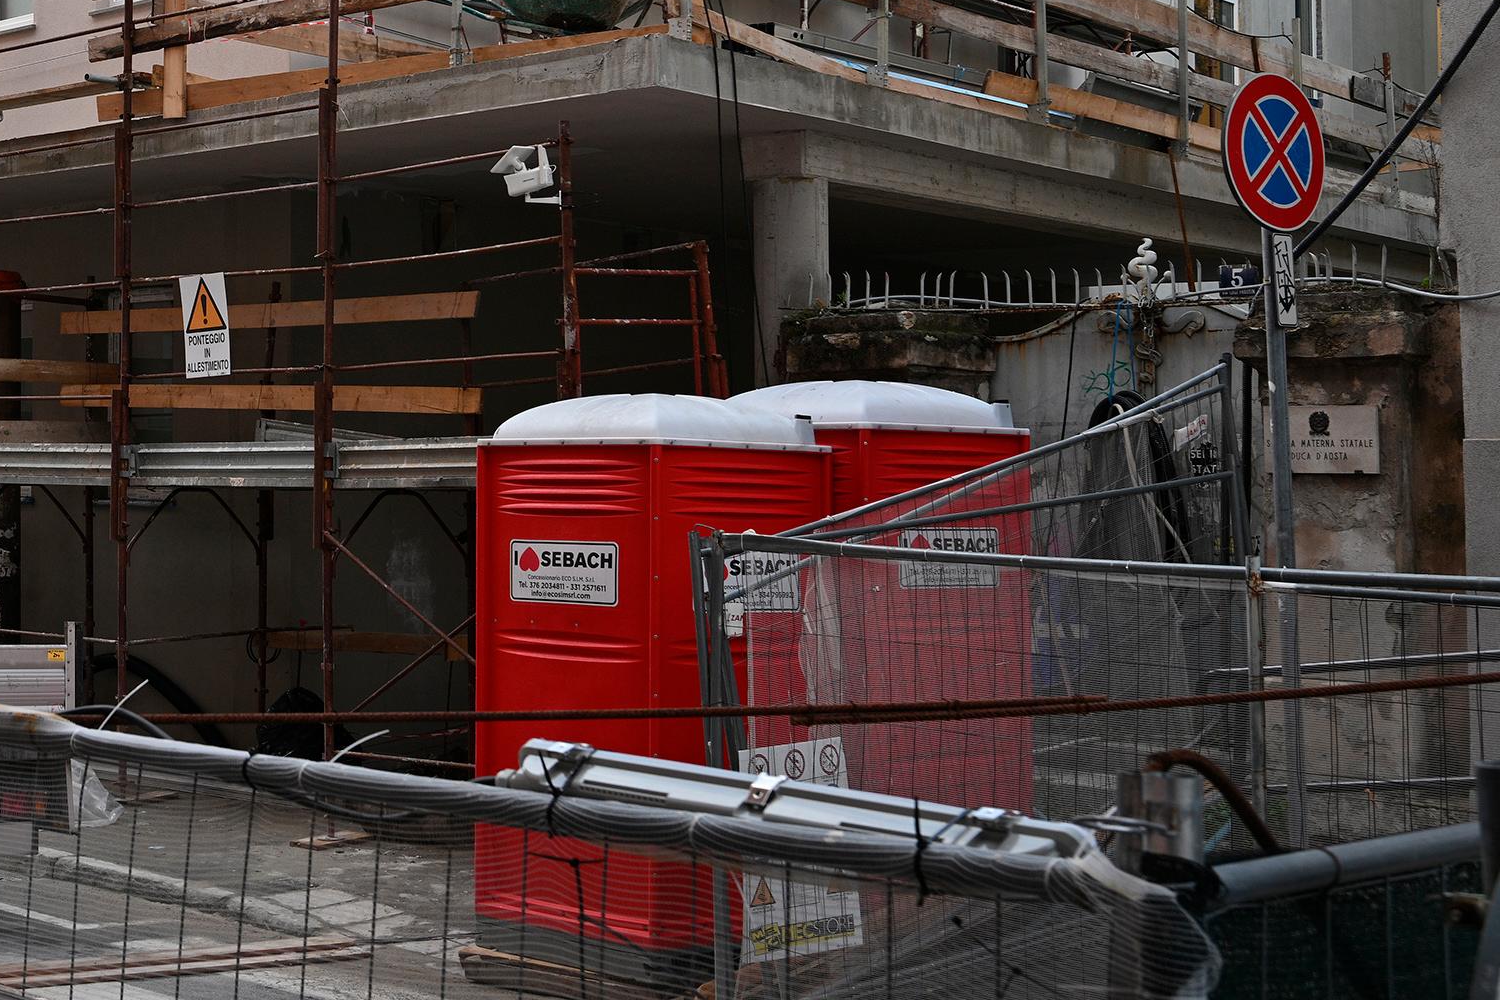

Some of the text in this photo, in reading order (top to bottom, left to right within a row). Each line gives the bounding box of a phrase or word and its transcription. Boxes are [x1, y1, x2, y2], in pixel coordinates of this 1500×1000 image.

[1231, 268, 1244, 287] 5
[188, 333, 226, 346] PONTEGGIO
[203, 347, 211, 358] IN
[187, 359, 230, 373] ALLESTIMENTO
[1300, 439, 1335, 448] MATERNA
[1340, 439, 1373, 448] STATALE
[1316, 451, 1348, 460] D'AOSTA
[932, 537, 996, 553] SEBACH
[540, 551, 613, 569] SEBACH
[531, 590, 591, 600] info@ecosimsrl.com
